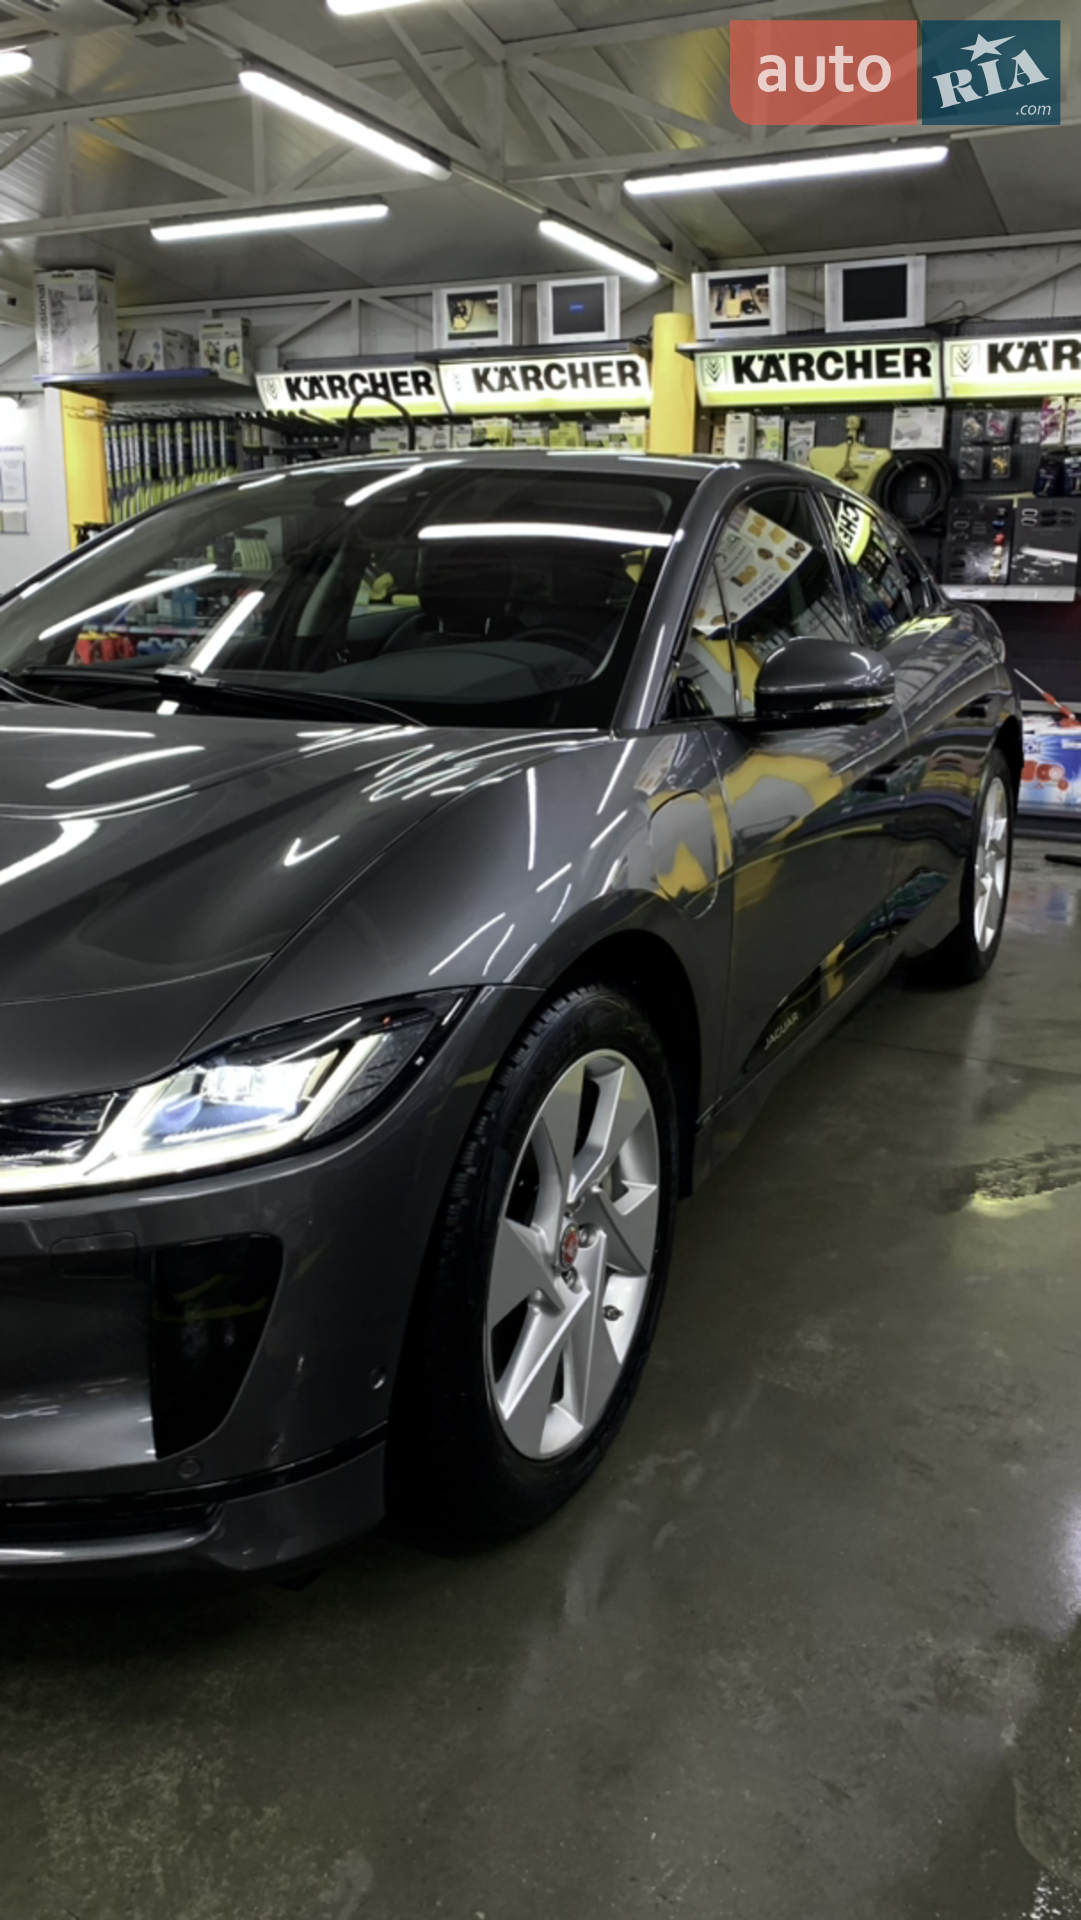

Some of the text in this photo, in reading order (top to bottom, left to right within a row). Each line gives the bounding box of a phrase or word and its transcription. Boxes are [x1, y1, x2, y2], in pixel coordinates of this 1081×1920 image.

[36, 284, 50, 364] Professional
[284, 369, 436, 401] KÄRCHER
[472, 359, 642, 393] KÄRCHER
[732, 347, 932, 385] KÄRCHER
[764, 1011, 799, 1051] JAGUAR
